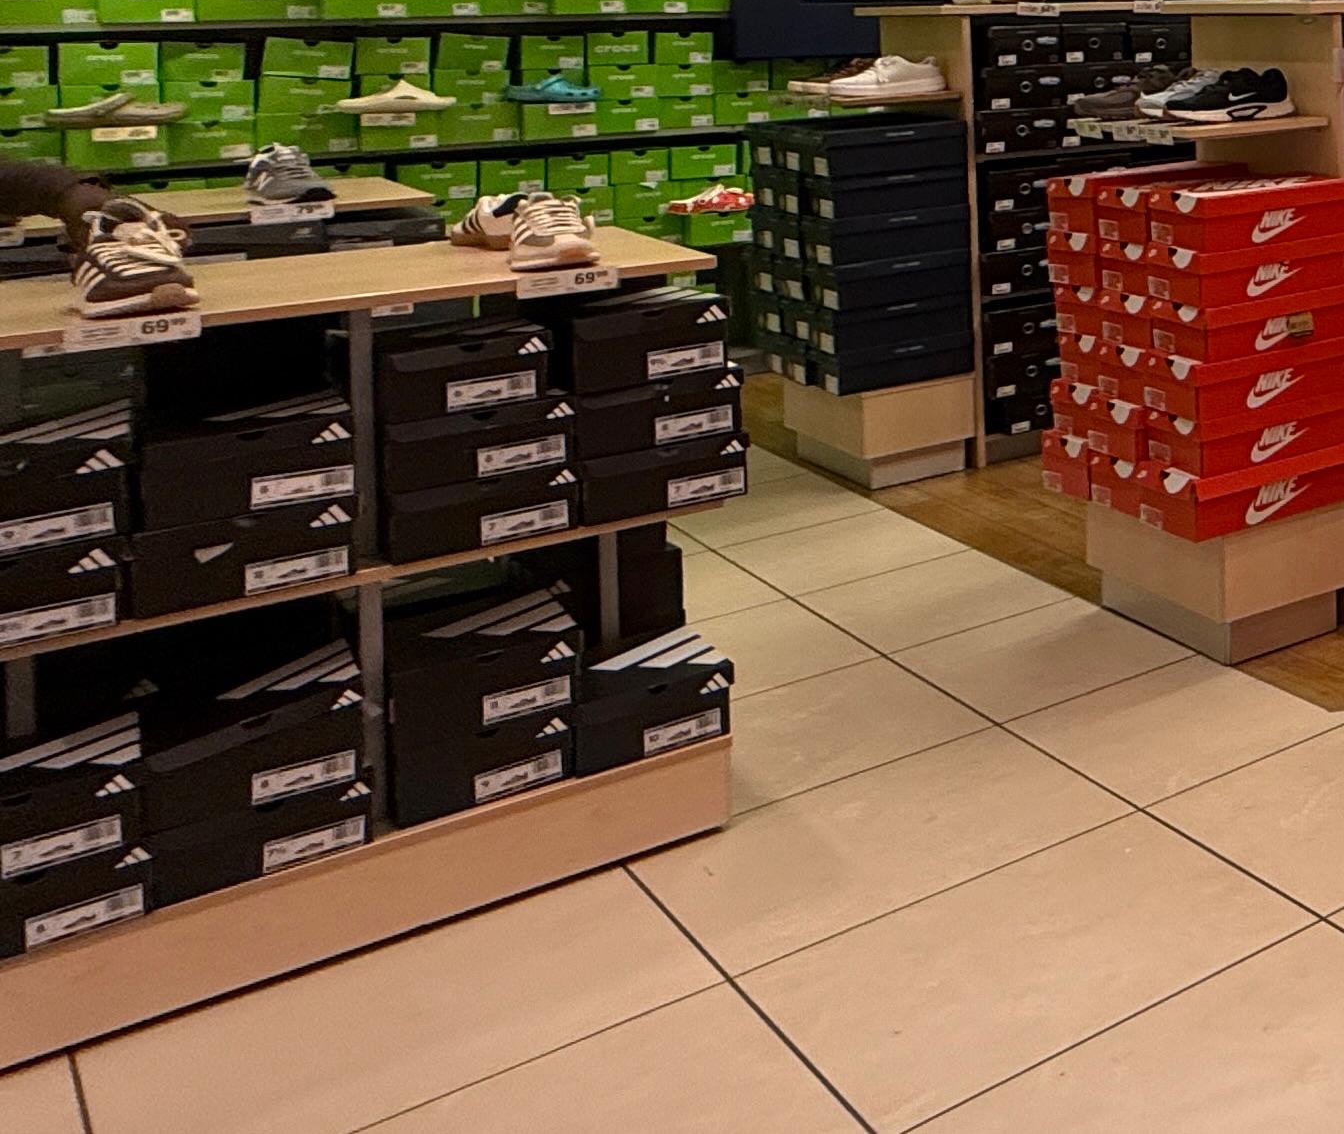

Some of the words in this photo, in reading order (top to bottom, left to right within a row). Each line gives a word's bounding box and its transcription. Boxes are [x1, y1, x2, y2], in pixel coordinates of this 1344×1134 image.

[594, 43, 641, 55] crocs
[1259, 207, 1296, 228] NIKE
[1255, 260, 1290, 282] NIKE
[1263, 315, 1289, 337] NIK
[1255, 368, 1294, 393] NIKE
[1259, 421, 1298, 447] NIKE
[1255, 476, 1298, 507] NIKE
